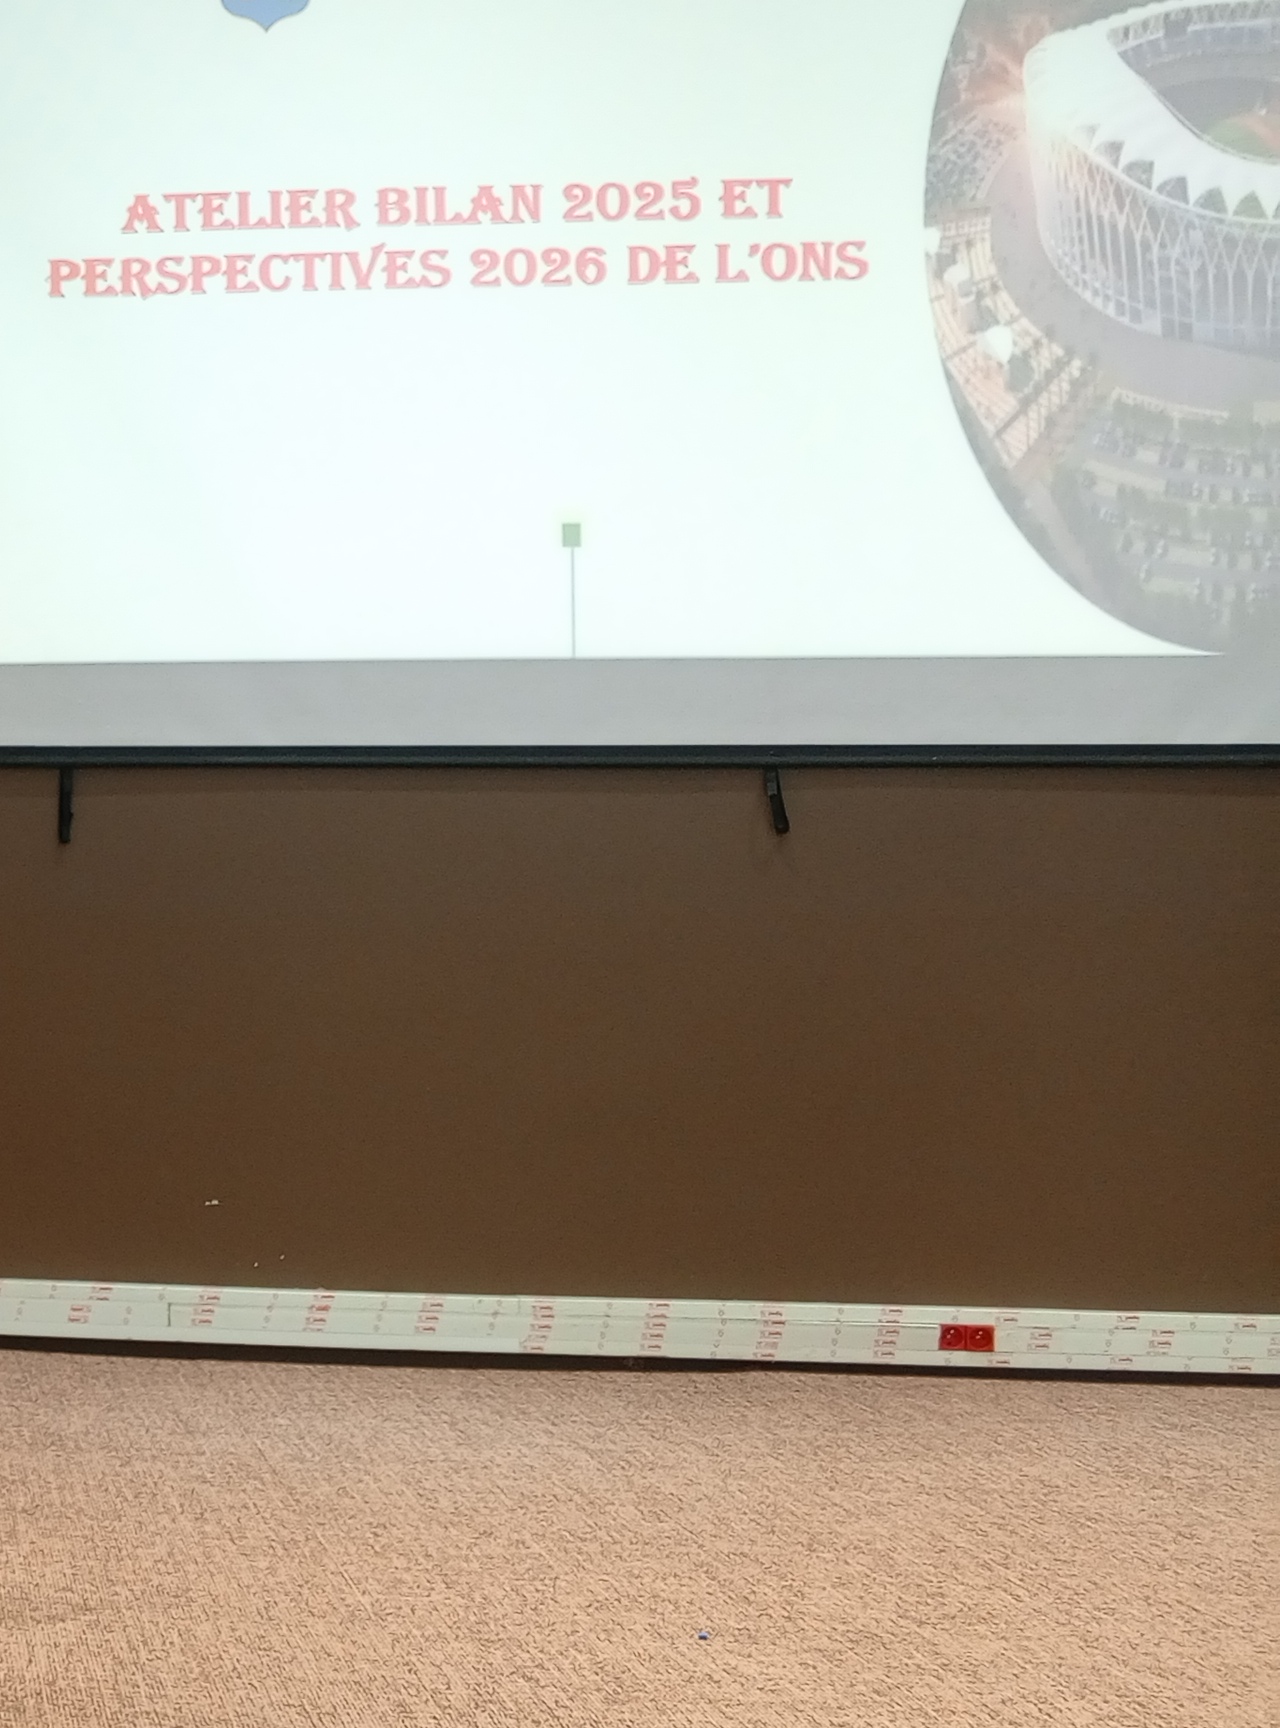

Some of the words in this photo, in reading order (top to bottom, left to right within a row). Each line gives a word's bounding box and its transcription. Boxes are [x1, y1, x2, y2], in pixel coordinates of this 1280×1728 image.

[121, 188, 361, 234] ATELIER
[375, 184, 544, 227] BILAN
[562, 176, 702, 223] 2025
[718, 177, 794, 219] ET
[44, 243, 453, 300] PERSPECTIVES
[469, 246, 608, 288] 2026
[627, 244, 701, 285] DE
[715, 240, 871, 283] L'ONS
